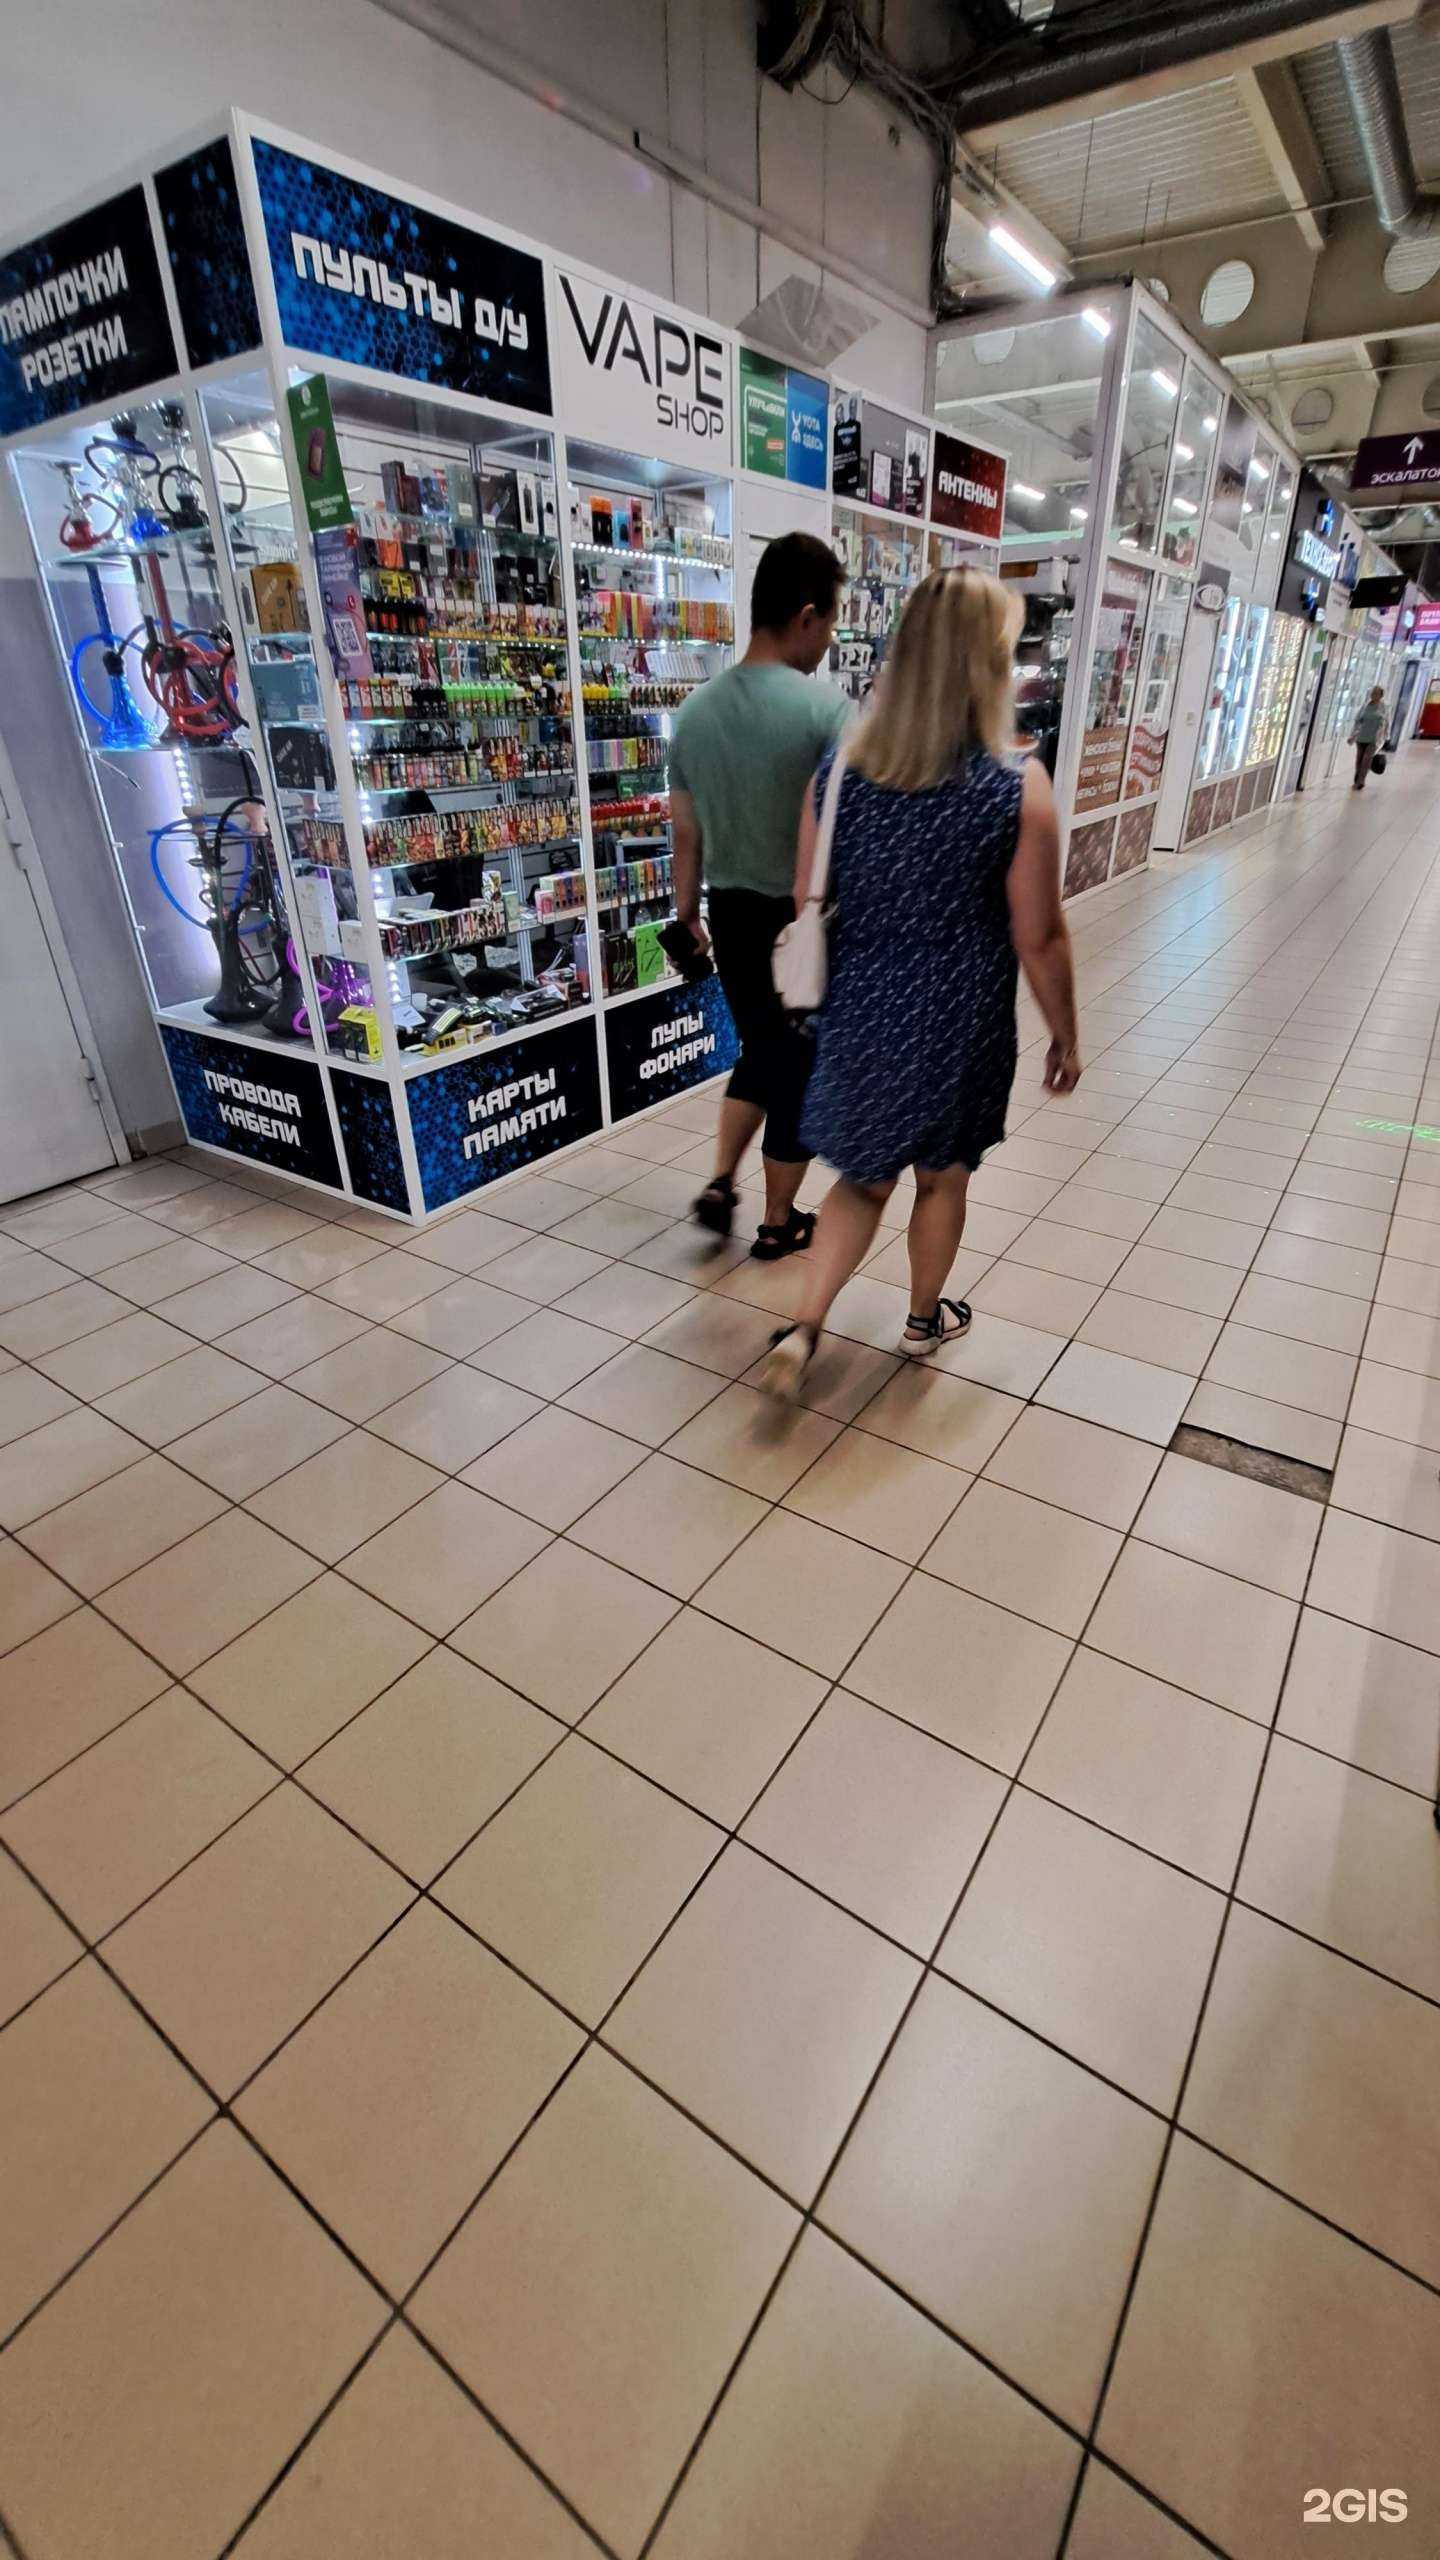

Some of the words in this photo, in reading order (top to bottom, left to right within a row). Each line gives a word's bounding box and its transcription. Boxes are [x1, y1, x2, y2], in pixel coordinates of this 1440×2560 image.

[0, 245, 128, 345] ЛАМПОЧКИ
[290, 231, 462, 330] ПУЛЬТЫ
[474, 298, 528, 350] Д/У
[20, 314, 128, 394] РОЗЕТКИ
[558, 273, 724, 410] VAPE
[656, 393, 724, 440] SHOP
[938, 470, 998, 509] АНТЕННЫ
[650, 1010, 703, 1049] ЛУПЫ
[639, 1033, 716, 1080] ФОНАРИ
[203, 1069, 302, 1119] ПРОВОДА
[467, 1067, 556, 1123] КАРТЫ
[218, 1101, 302, 1148] КАБЕЛИ
[462, 1095, 567, 1160] ПАМЯТИ
